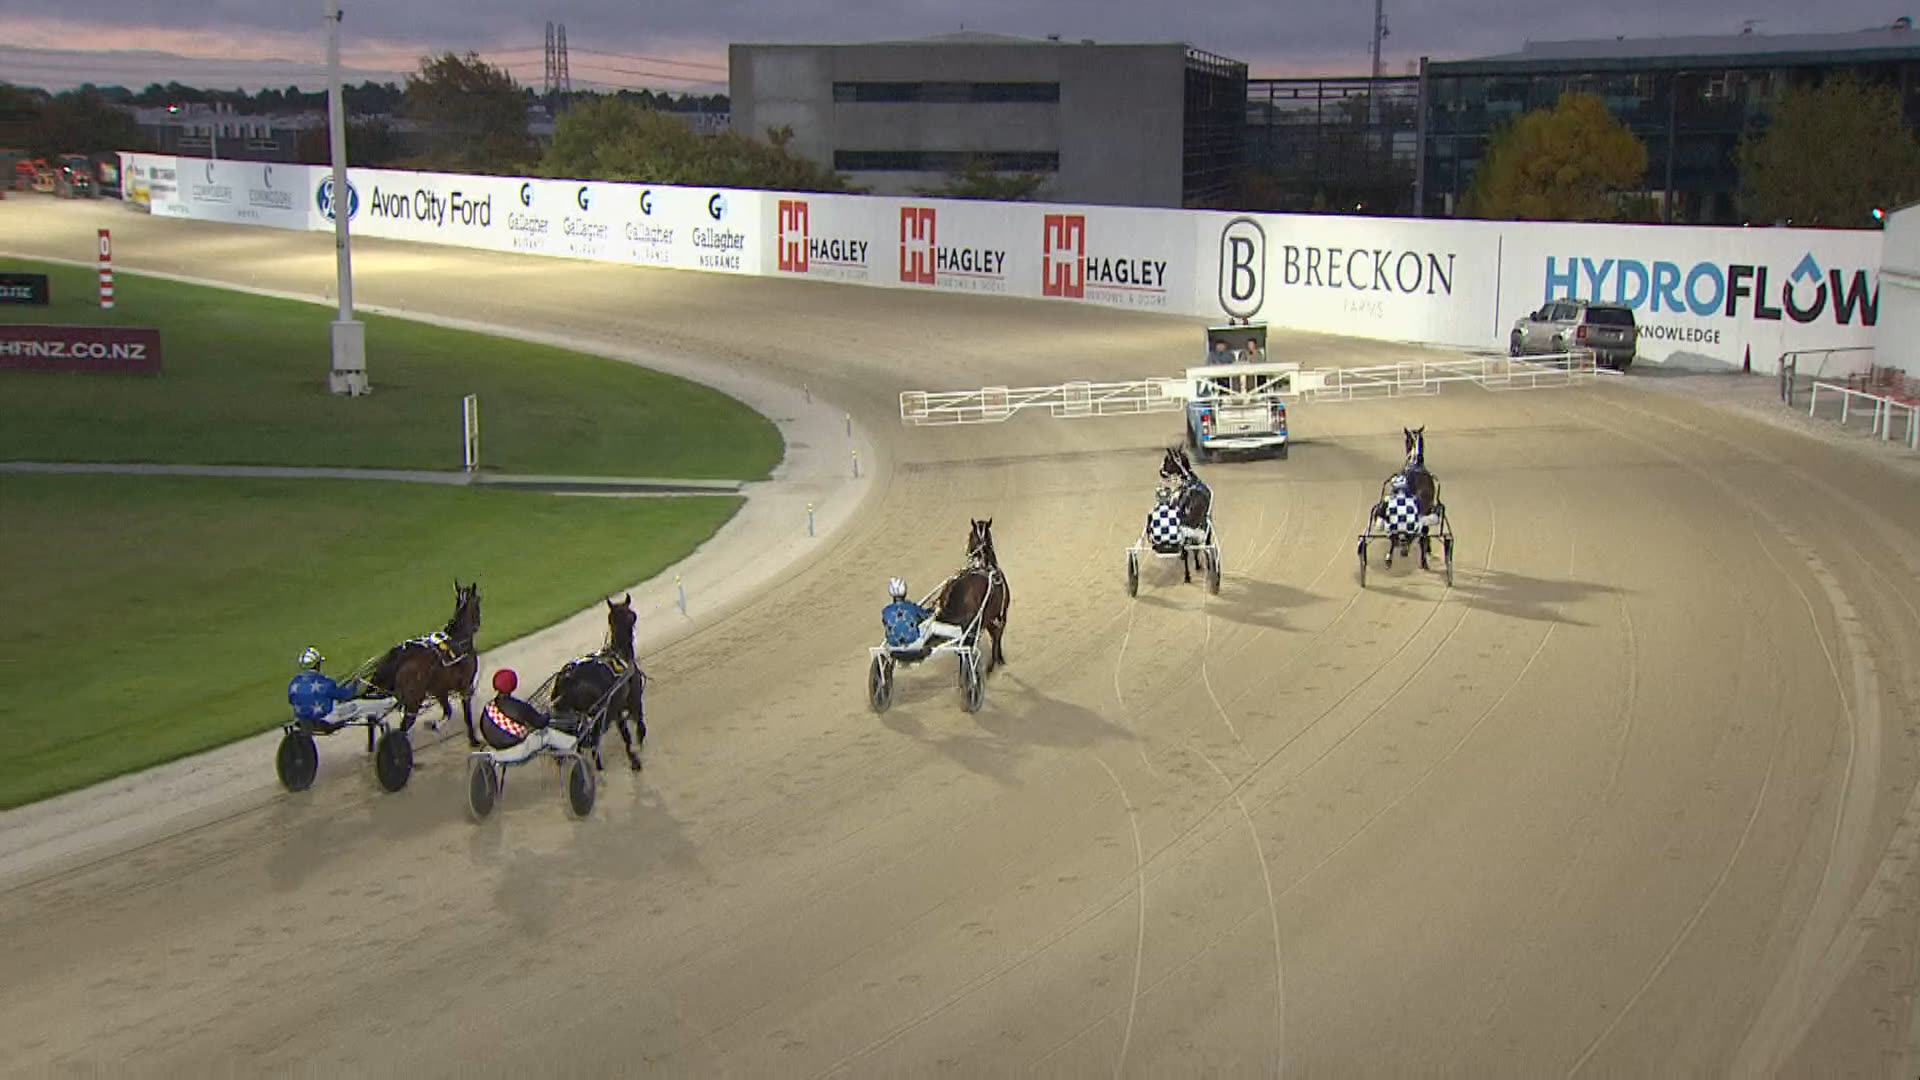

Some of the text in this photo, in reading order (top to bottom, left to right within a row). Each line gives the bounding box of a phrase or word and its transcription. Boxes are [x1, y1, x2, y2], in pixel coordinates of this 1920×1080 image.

[371, 186, 493, 227] Avon City Ford
[100, 237, 109, 255] 0
[692, 227, 746, 252] Gallagher
[810, 239, 868, 263] HAGLEY
[938, 247, 1004, 273] HAGLEY
[1086, 257, 1167, 287] HAGLEY
[1229, 236, 1257, 301] B
[1284, 245, 1457, 296] BRECKON
[1544, 252, 1881, 327] HYDROFLOW
[1635, 324, 1720, 345] KNOWLEDGE
